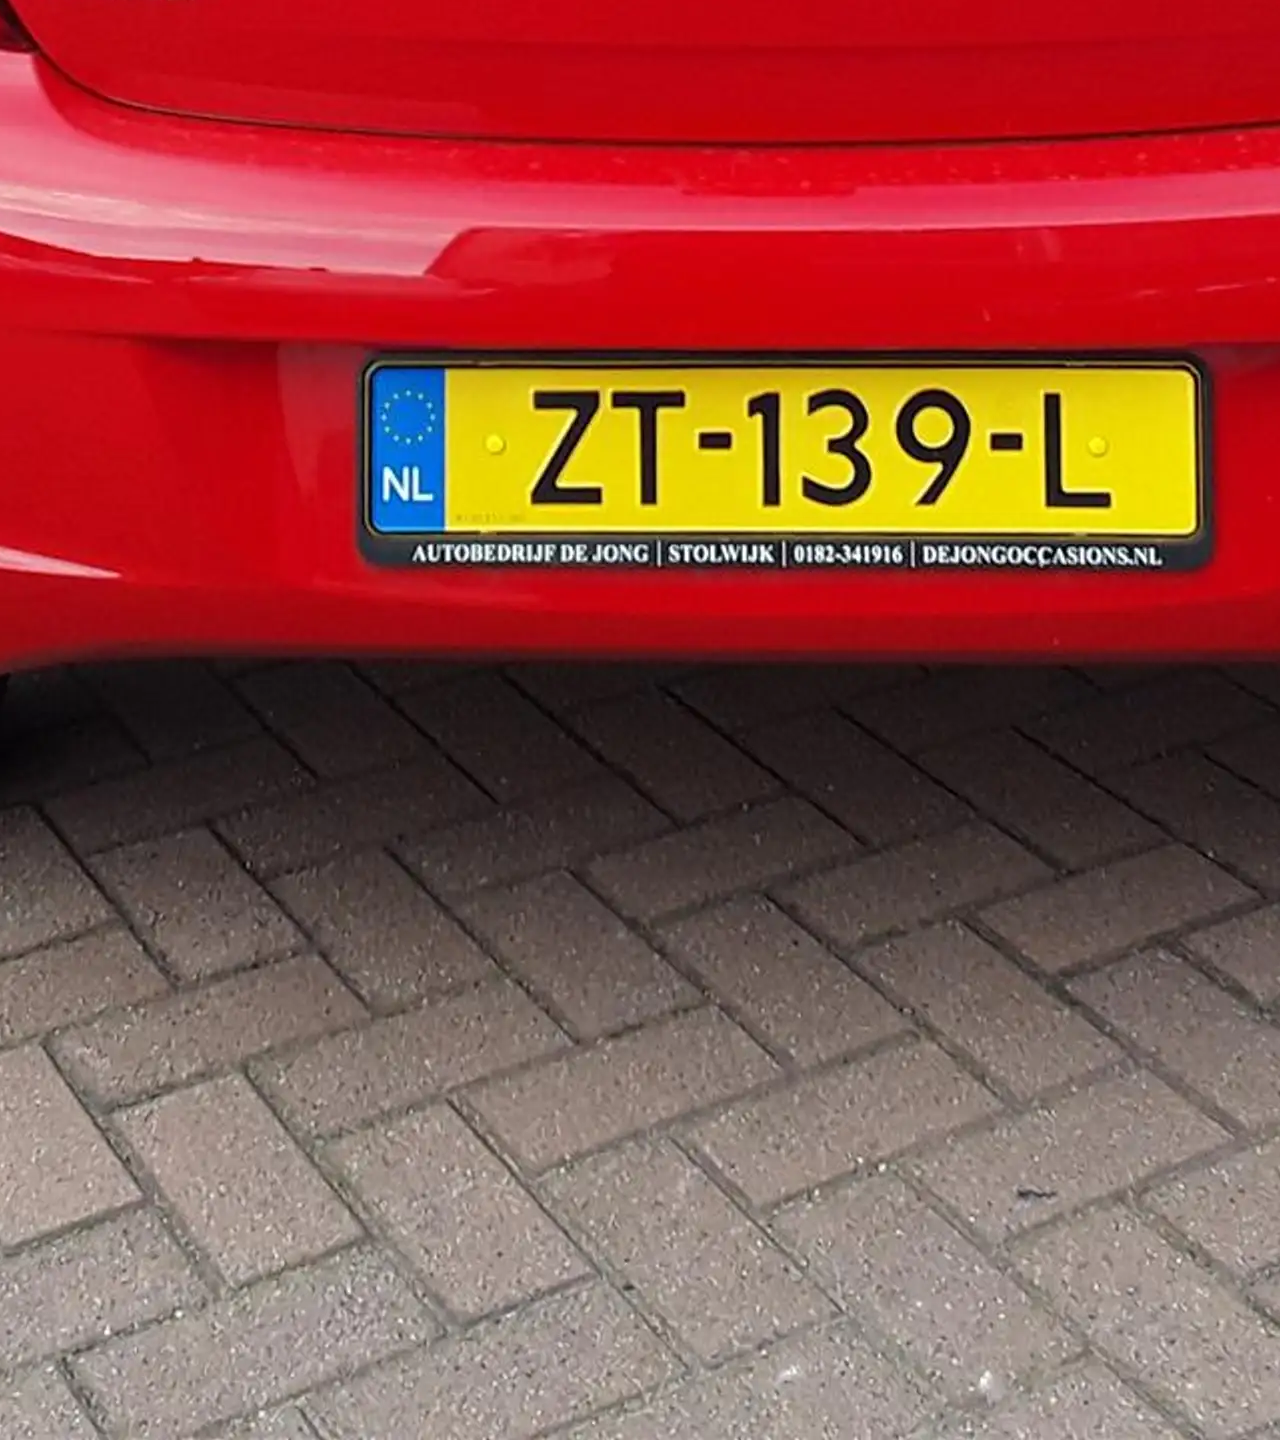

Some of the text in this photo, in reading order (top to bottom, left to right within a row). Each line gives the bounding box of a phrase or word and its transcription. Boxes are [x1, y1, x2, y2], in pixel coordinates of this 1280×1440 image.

[530, 388, 1112, 508] ZT-139-L
[382, 465, 434, 503] NL
[412, 543, 1163, 568] AUTOBEDRIJF DE JONG STOLWIJK 0182-341916 DEJONGOCCASIONS.NL
